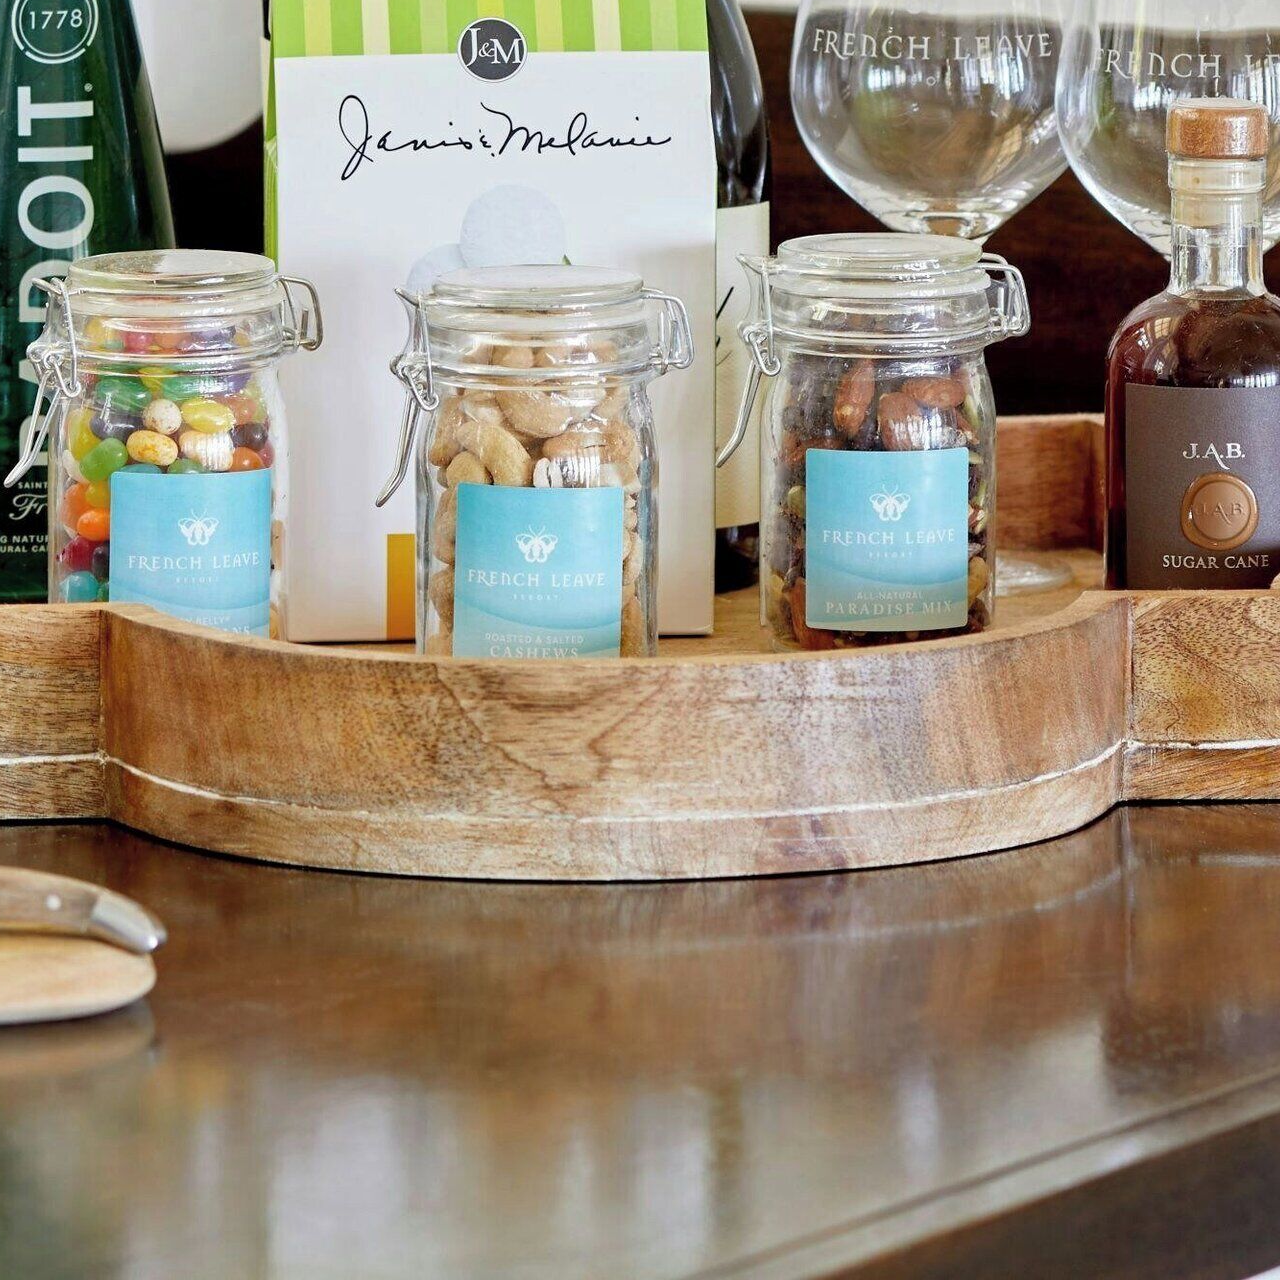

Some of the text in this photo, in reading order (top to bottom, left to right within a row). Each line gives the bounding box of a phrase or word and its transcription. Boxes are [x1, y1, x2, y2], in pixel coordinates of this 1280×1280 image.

[28, 8, 84, 31] 1778
[465, 26, 523, 68] J&M
[812, 28, 1053, 61] FRENCH LEAVE
[1094, 47, 1222, 80] FRENCH
[1182, 442, 1246, 470] J.A.B.
[822, 527, 956, 548] FRENCH LEAVE
[128, 552, 260, 572] FRENCH LEAVE
[1162, 554, 1270, 570] SUGAR CANE
[468, 569, 607, 588] FRENCH LEAVE
[825, 600, 953, 616] PARADISE MIX
[485, 631, 532, 644] ROASTED
[545, 635, 585, 645] SALTED
[489, 645, 579, 659] CASHEWS
